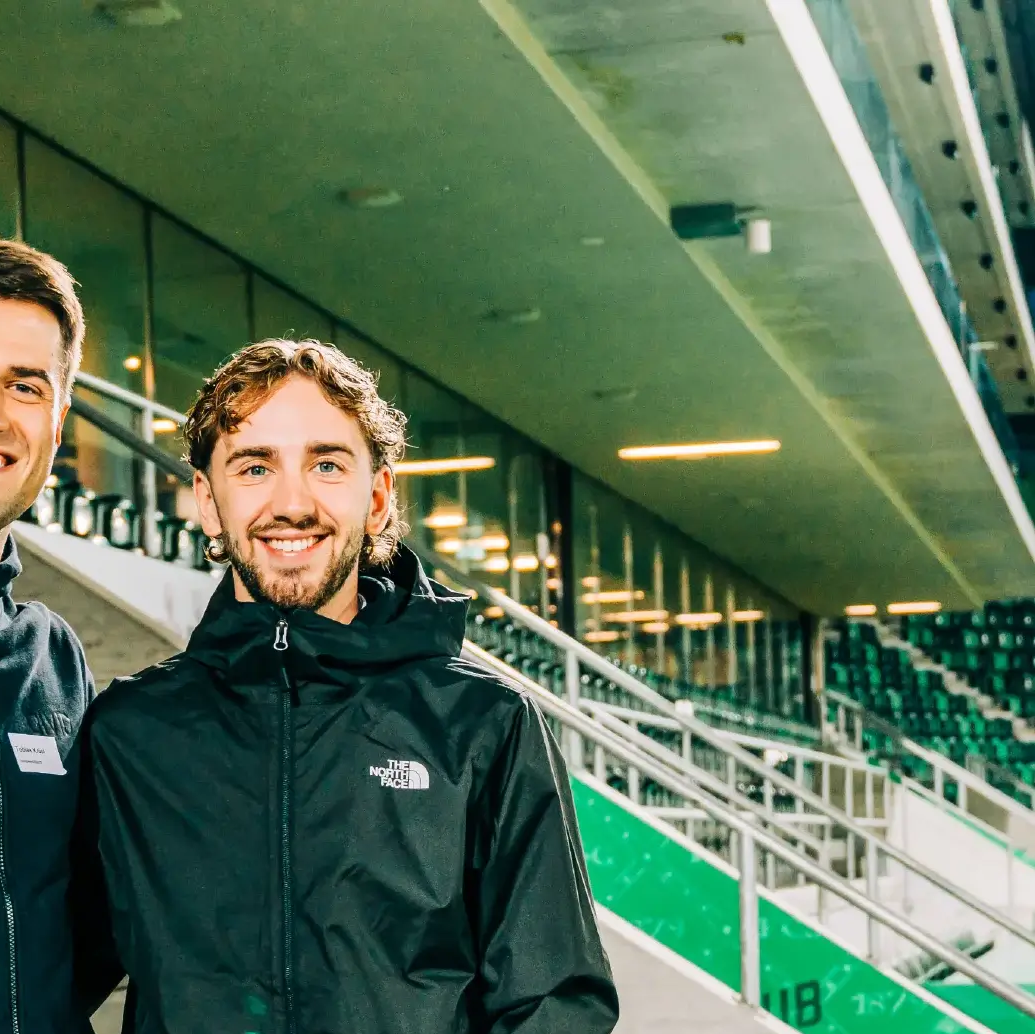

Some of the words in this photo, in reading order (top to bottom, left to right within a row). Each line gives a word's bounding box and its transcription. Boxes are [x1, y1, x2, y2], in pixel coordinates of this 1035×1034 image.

[387, 759, 409, 770] THE
[369, 766, 409, 780] NORTH
[381, 777, 409, 788] FACE
